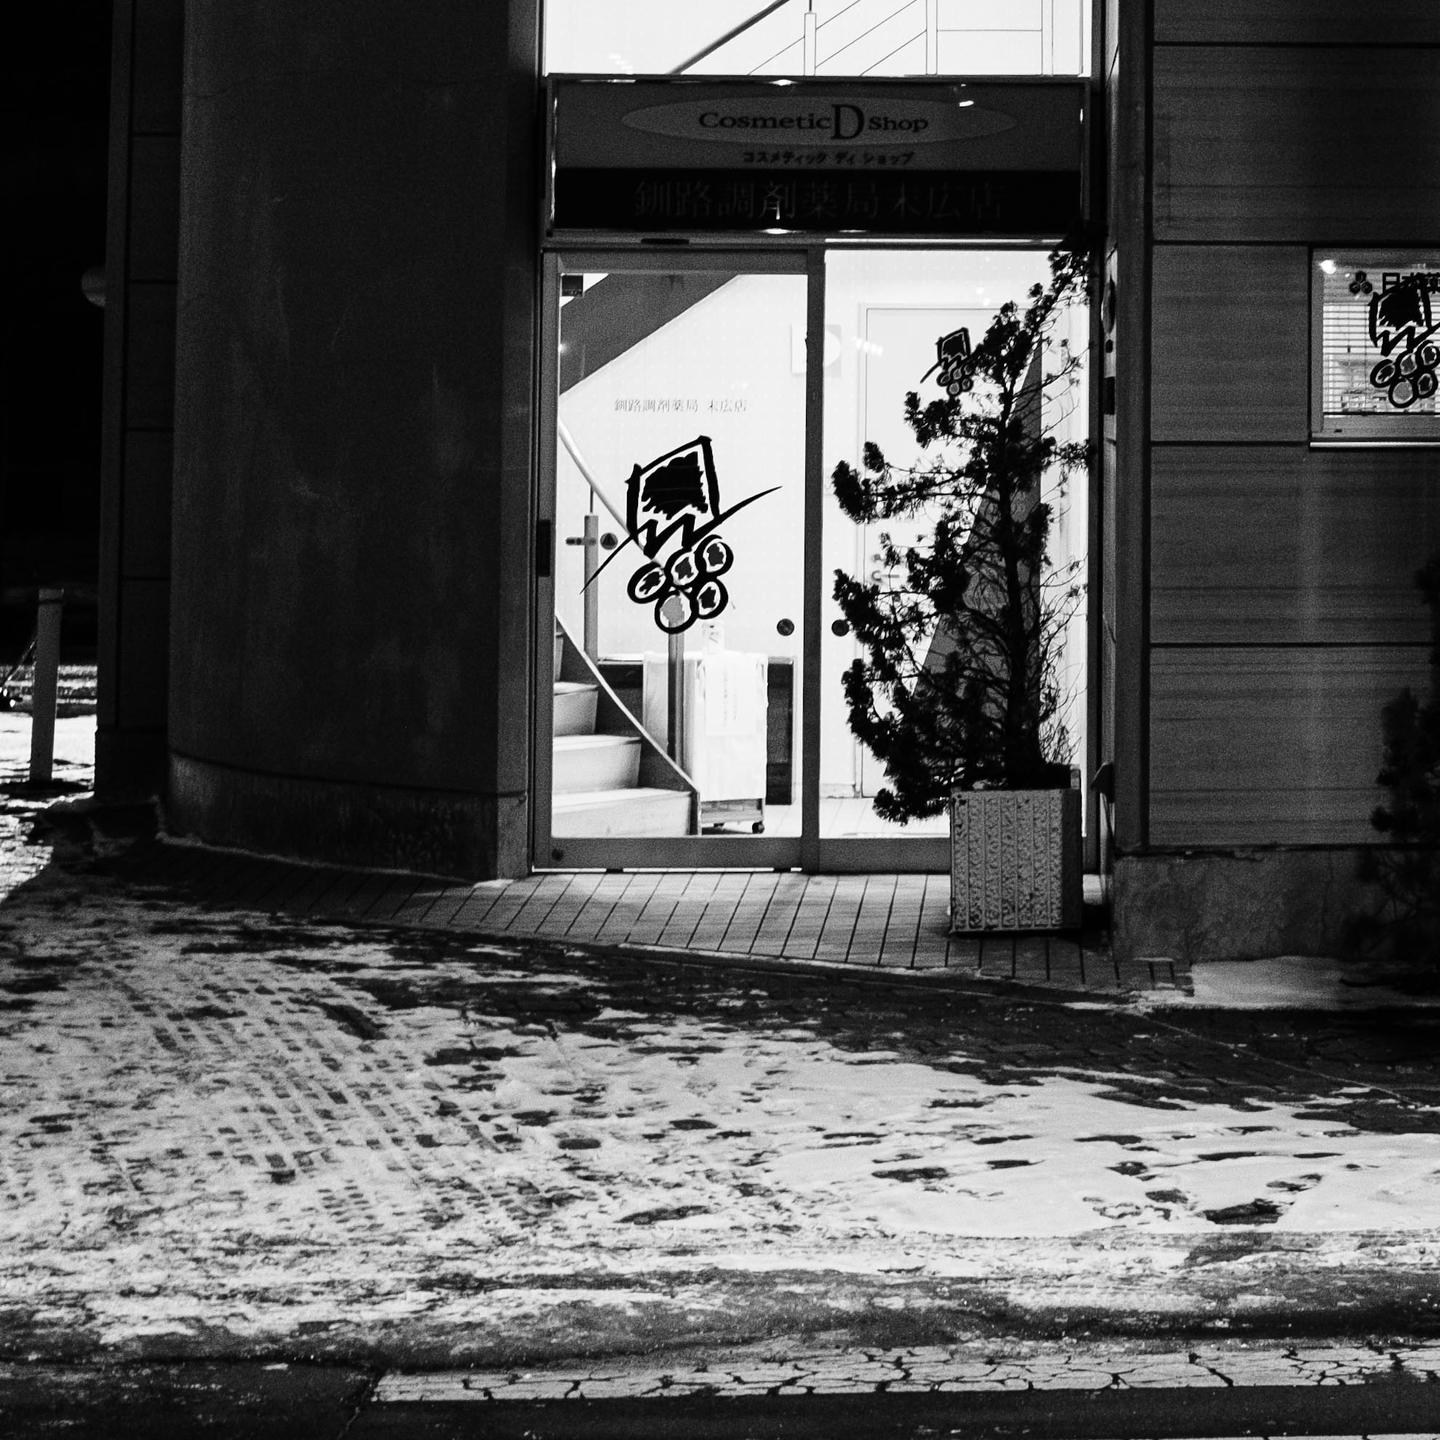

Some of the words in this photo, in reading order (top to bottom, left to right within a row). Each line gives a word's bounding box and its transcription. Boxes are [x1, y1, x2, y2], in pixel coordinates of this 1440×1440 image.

[699, 111, 830, 129] Cosmetic
[830, 104, 864, 140] D
[868, 115, 929, 134] Shop
